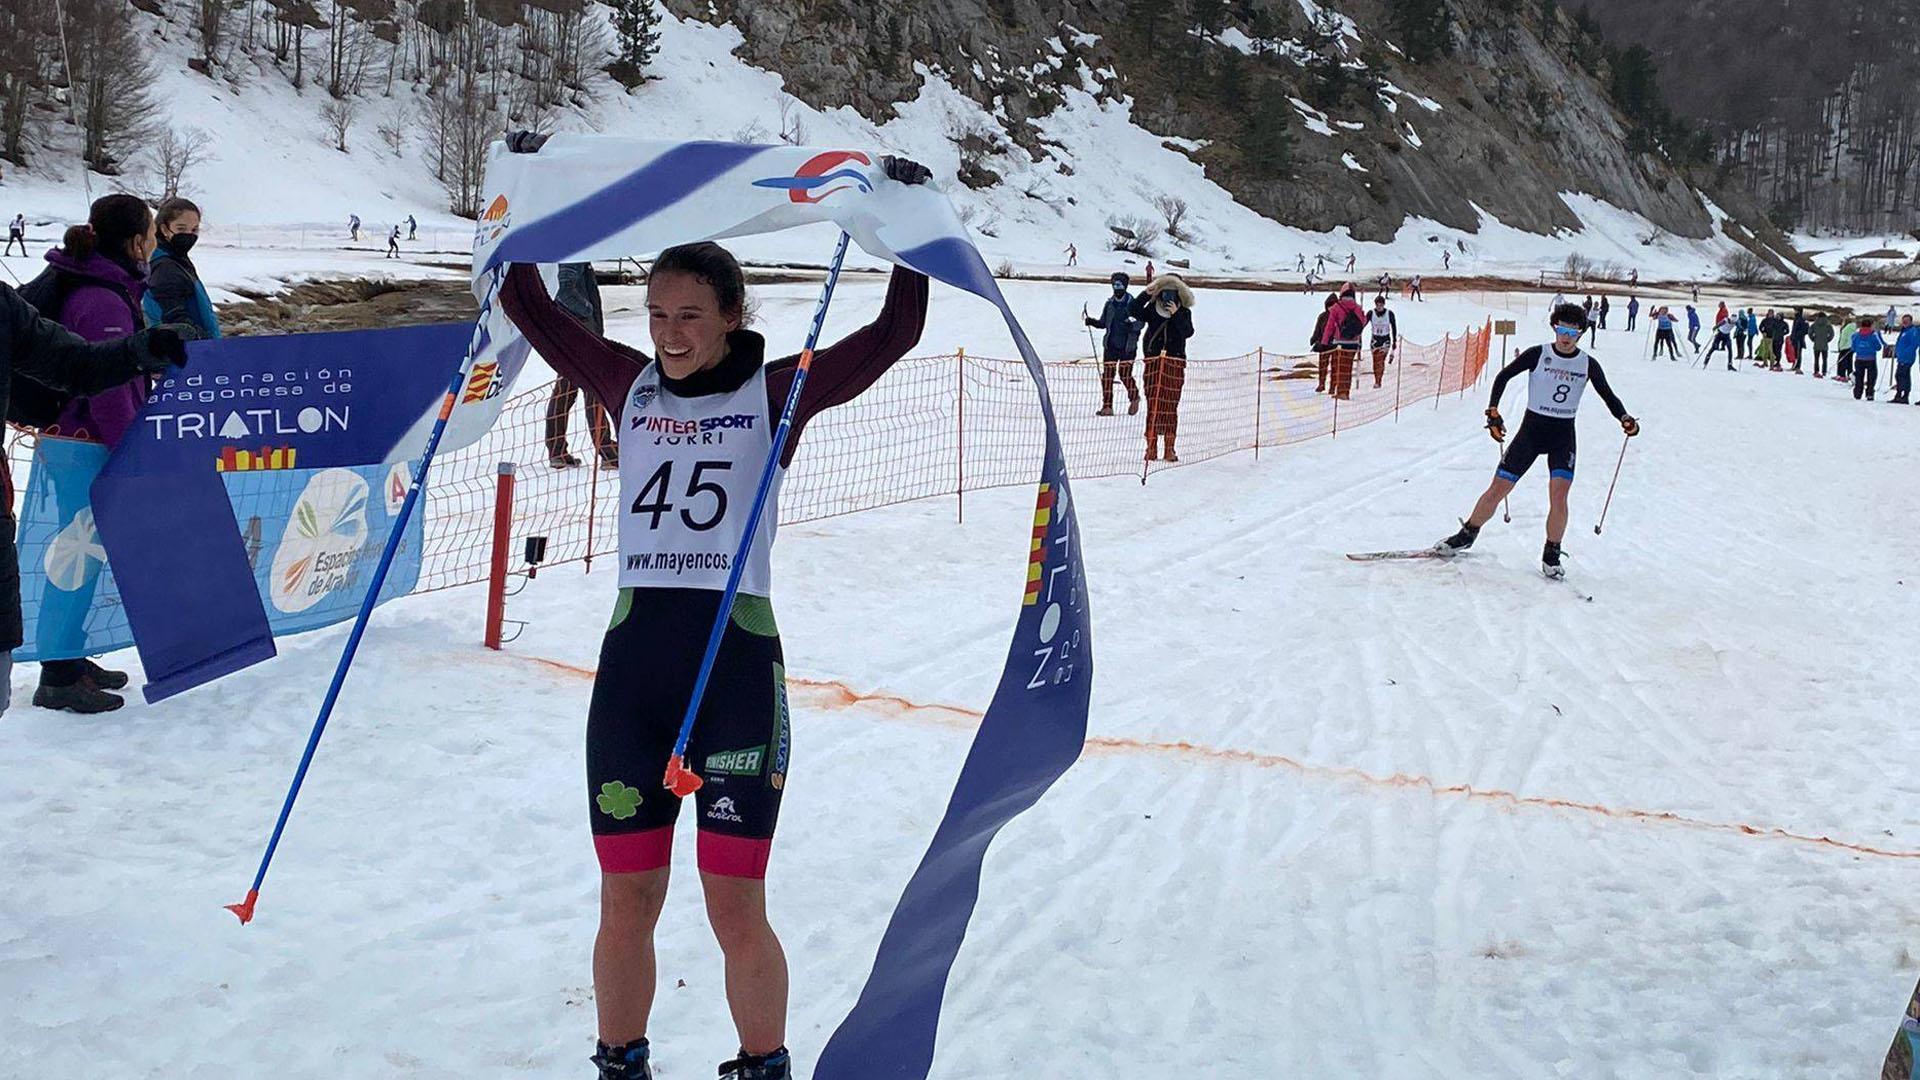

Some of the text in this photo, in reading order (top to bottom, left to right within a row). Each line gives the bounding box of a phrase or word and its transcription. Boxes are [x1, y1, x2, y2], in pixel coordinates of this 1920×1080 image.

[163, 368, 353, 389] ederación
[147, 381, 353, 405] aragonesa de
[1552, 384, 1571, 403] 8
[145, 406, 350, 440] TRIATLON
[645, 414, 757, 434] INTERSPORT
[631, 460, 733, 532] 45
[626, 551, 735, 576] www.mayencos.
[705, 750, 760, 770] FINISHER
